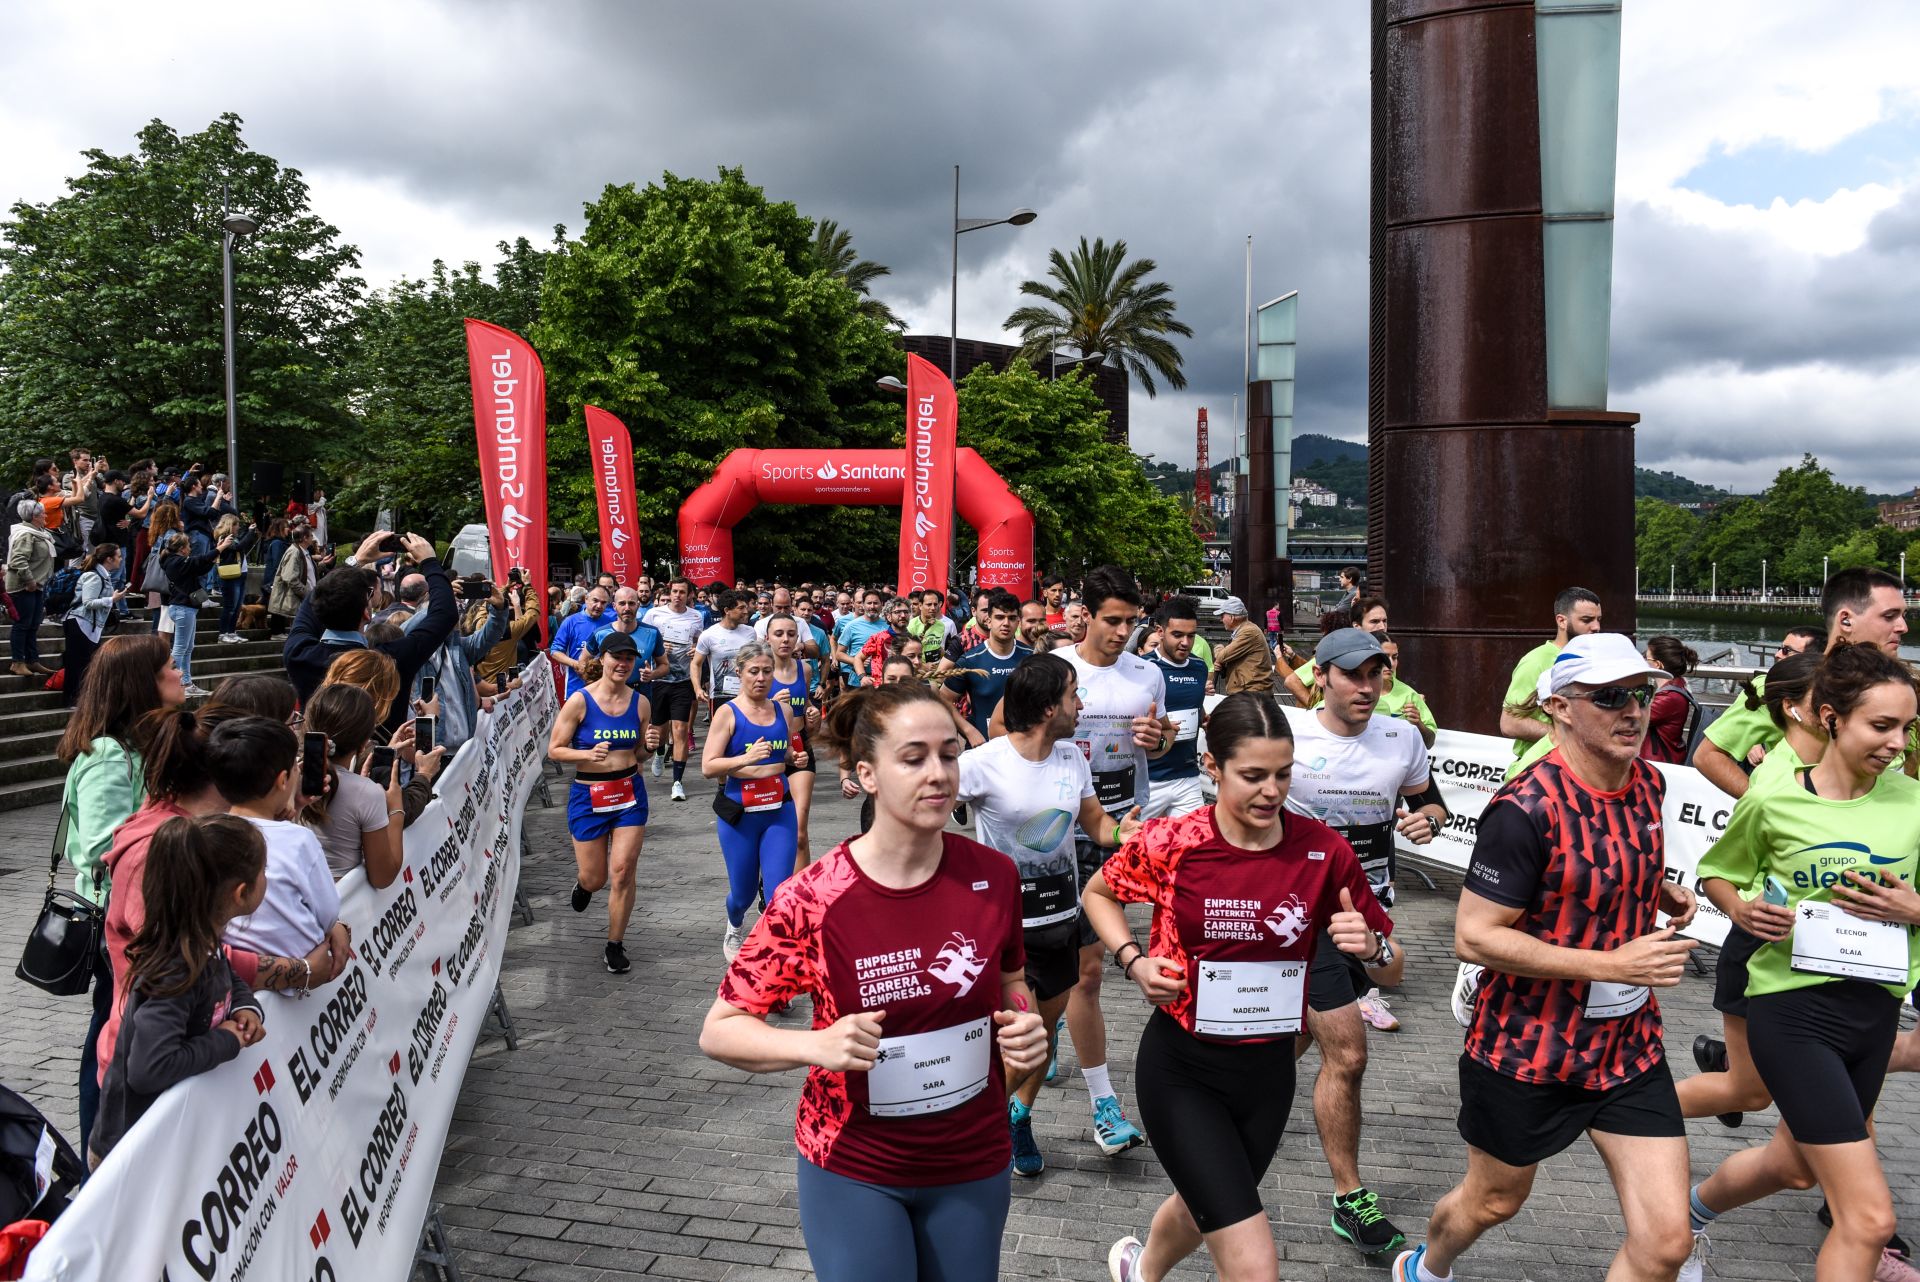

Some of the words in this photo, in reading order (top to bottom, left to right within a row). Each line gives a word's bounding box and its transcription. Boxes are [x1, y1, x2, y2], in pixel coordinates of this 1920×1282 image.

[762, 463, 814, 483] Sports
[685, 543, 709, 552] Sports
[989, 547, 1015, 557] Sports
[684, 555, 721, 564] Santander
[986, 560, 1026, 570] Santander
[992, 667, 1016, 675] Saym
[593, 729, 637, 739] ZOSMA
[745, 740, 788, 753] ZMA
[1302, 772, 1331, 780] arteche
[1476, 784, 1499, 795] BALIO
[1678, 802, 1706, 827] EL
[419, 865, 436, 899] EL
[430, 832, 460, 885] CORRE
[1019, 853, 1074, 877] rteche
[1819, 856, 1857, 867] grupo
[1472, 866, 1481, 877] THE
[1481, 872, 1500, 885] TEAM
[1475, 861, 1500, 878] ELEVATE
[1793, 863, 1909, 889] elecnr
[1039, 890, 1061, 898] ARTECHE
[1204, 898, 1261, 910] ENPRESEN
[1204, 909, 1256, 919] LASTERKETA
[359, 939, 382, 977] EL
[372, 886, 418, 959] CORREO
[1204, 920, 1256, 932] CARRERA
[1835, 927, 1868, 938] ELECNOR
[1204, 930, 1264, 941] DEMPRESAS
[855, 948, 922, 971] ENPRESEN
[1839, 947, 1863, 957] OLAIA
[446, 953, 462, 987] EL
[857, 961, 918, 981] LASTERKETA
[1281, 969, 1299, 978] 600
[859, 975, 920, 997] CARRERA
[1237, 986, 1269, 994] GRUNVER
[861, 984, 932, 1008] DEMPRESAS
[1232, 1006, 1271, 1014] NADEZHNA
[412, 980, 447, 1060] CORREO
[287, 1045, 322, 1106] EL
[310, 965, 368, 1069] CORREO
[964, 1027, 983, 1042] 600
[328, 1044, 361, 1102] INFORMACIÓN
[356, 1028, 368, 1051] CON
[408, 1043, 424, 1087] EL
[914, 1055, 951, 1070] GRUNVER
[922, 1080, 945, 1091] SARA
[340, 1184, 370, 1250] EL
[360, 1081, 408, 1204] CORREO
[377, 1169, 402, 1237] INFORMAZIO
[399, 1121, 419, 1172] BALIOTSUA
[181, 1101, 282, 1282] CORREO
[230, 1223, 262, 1282] RMACIÓN
[260, 1193, 277, 1231] CON
[274, 1153, 299, 1199] VALOR
